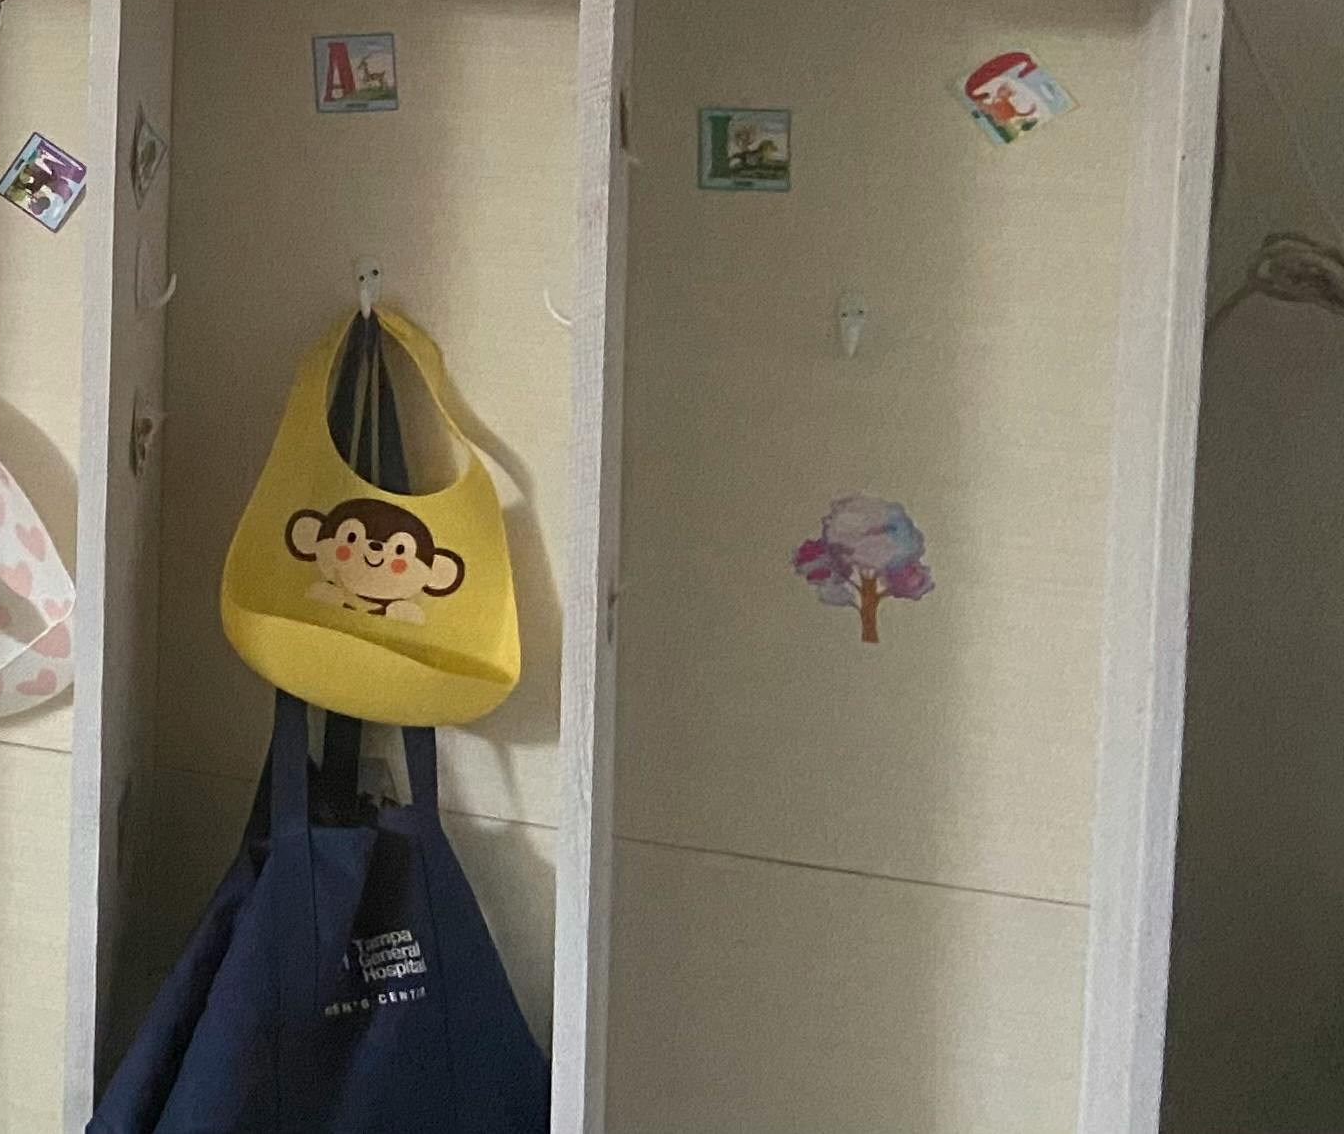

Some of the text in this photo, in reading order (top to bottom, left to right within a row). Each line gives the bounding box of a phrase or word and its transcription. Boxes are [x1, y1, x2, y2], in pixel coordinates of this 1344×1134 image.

[323, 42, 356, 102] A
[352, 929, 413, 952] Tampa
[359, 940, 421, 968] General
[362, 957, 427, 983] Hospital
